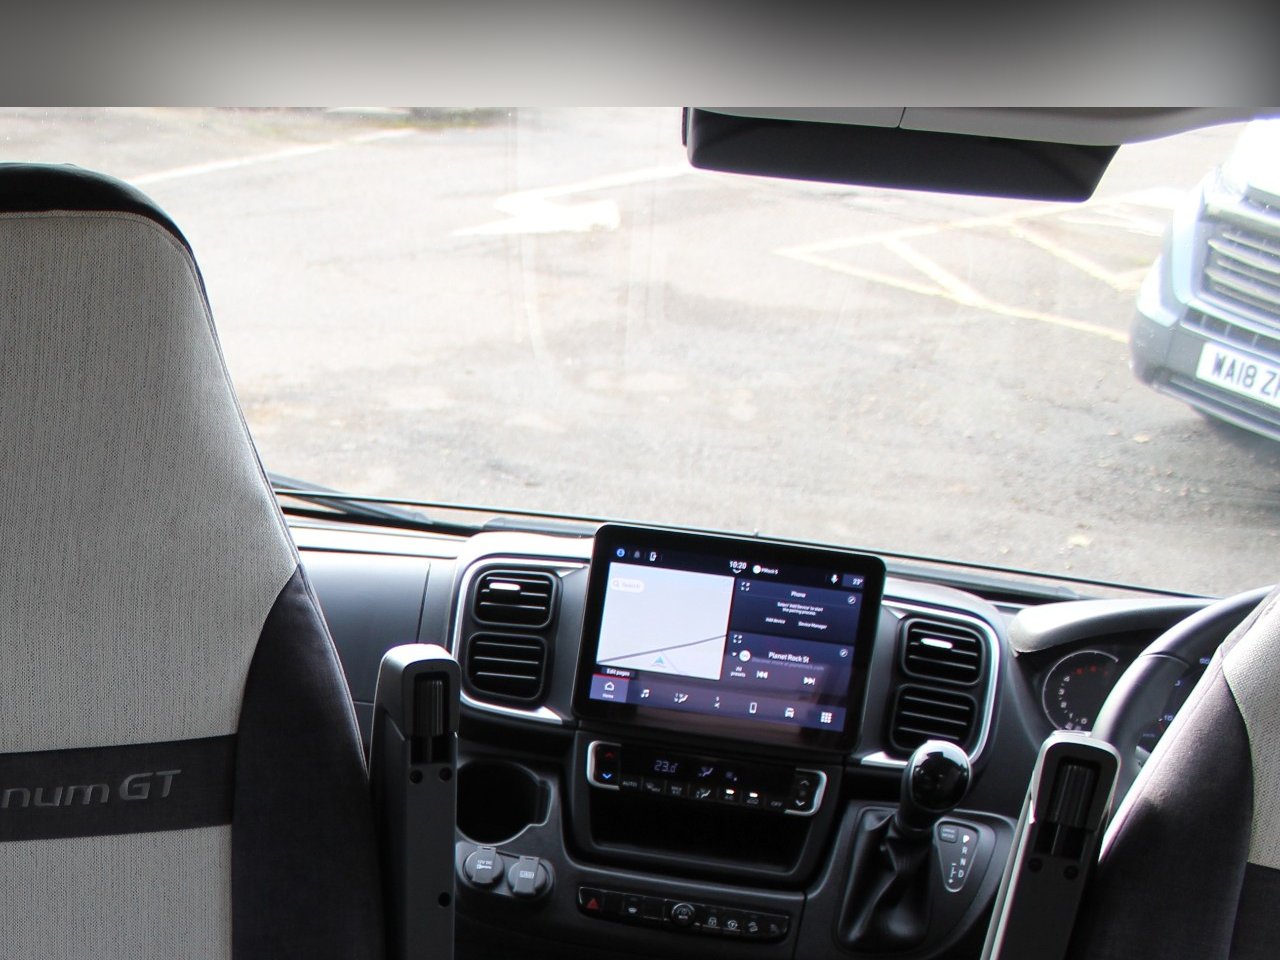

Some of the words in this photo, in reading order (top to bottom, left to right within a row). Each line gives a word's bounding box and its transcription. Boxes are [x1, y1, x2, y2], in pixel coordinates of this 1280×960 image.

[1211, 352, 1258, 389] WA18
[768, 651, 788, 660] Planet
[119, 769, 182, 801] GT
